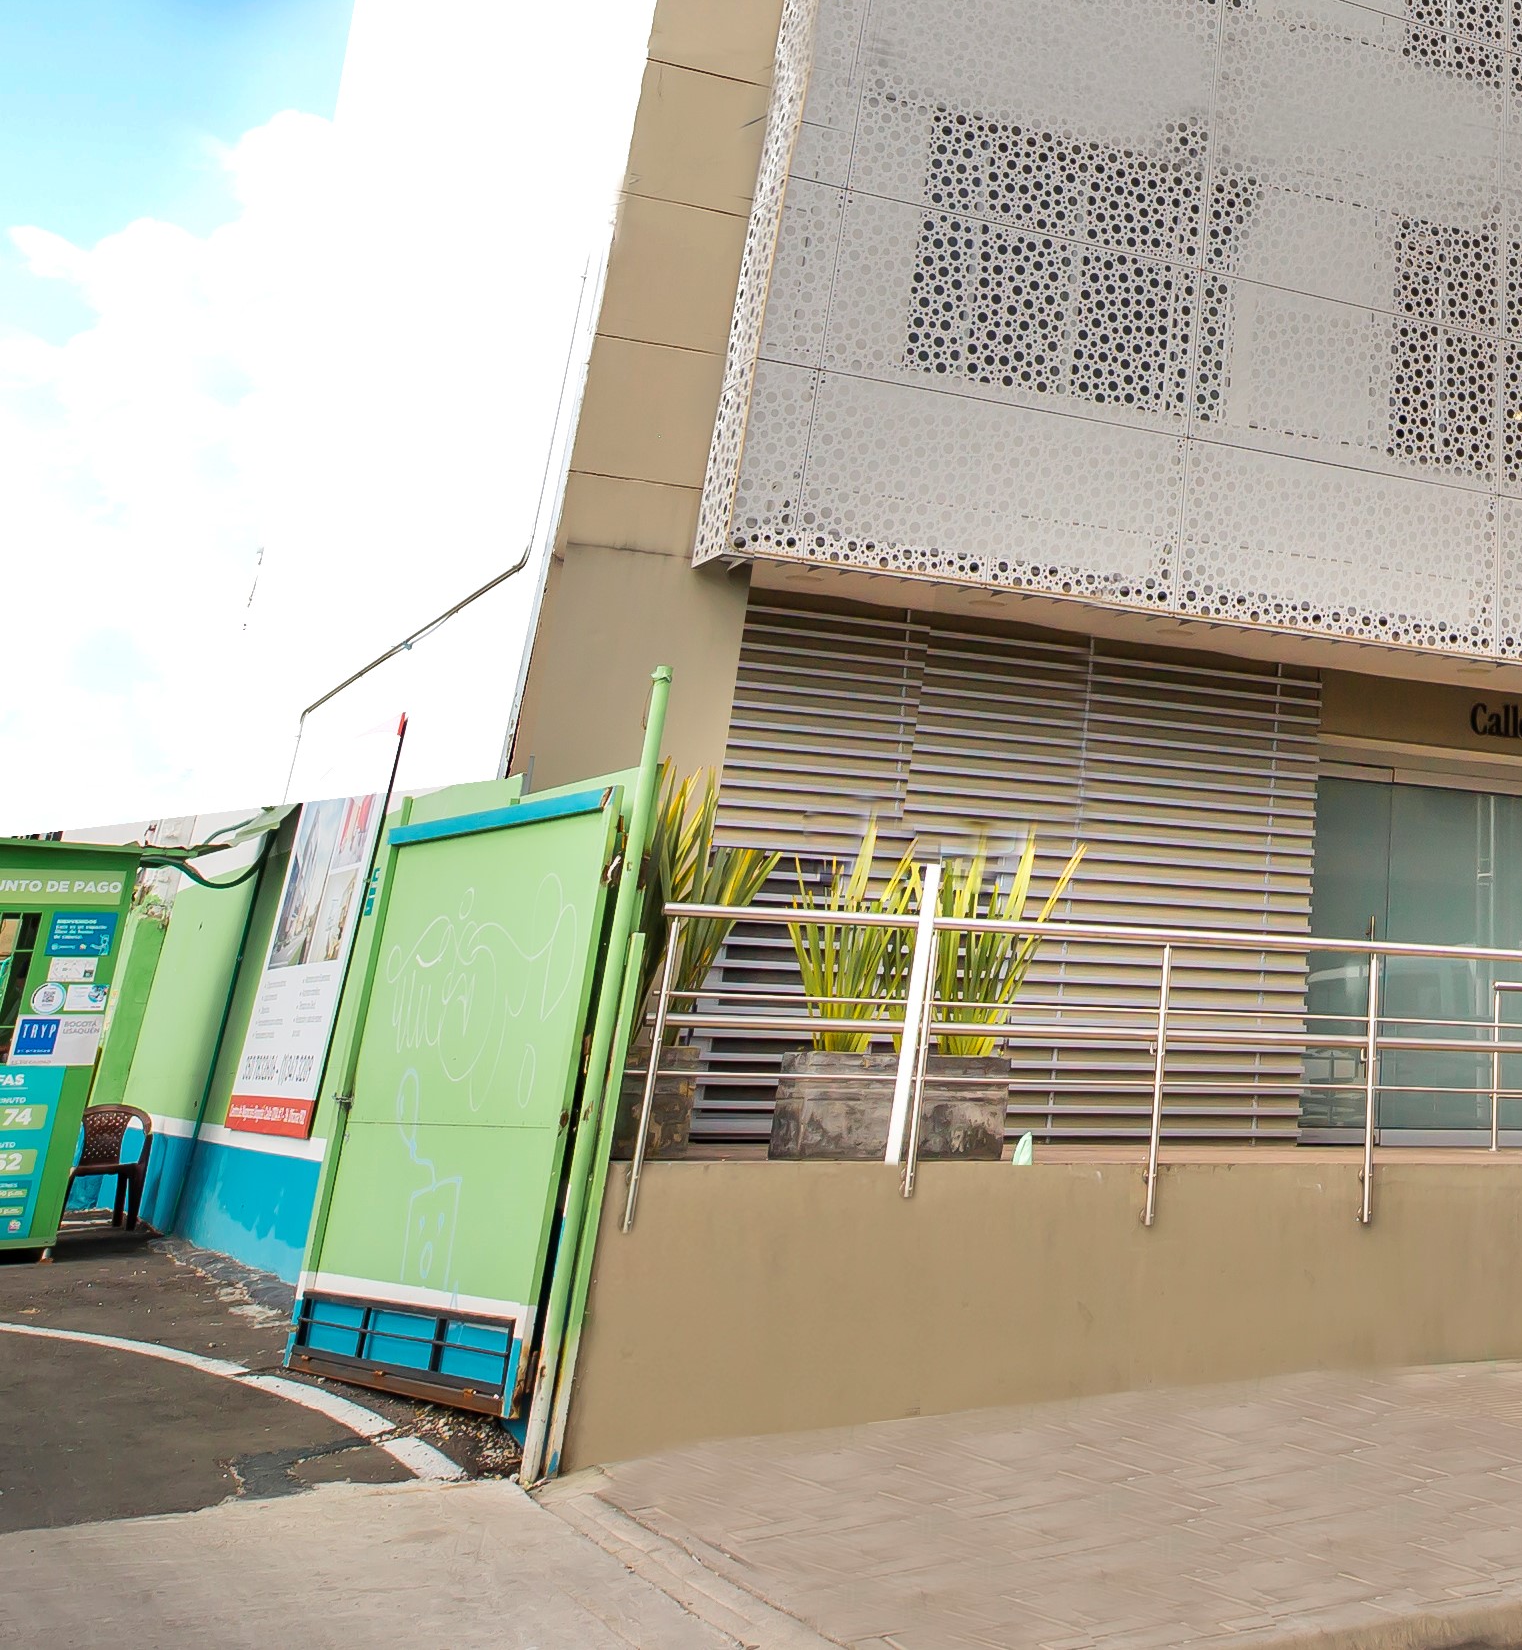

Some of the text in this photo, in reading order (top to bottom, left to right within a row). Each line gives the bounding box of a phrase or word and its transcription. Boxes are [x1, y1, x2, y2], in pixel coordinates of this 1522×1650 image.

[45, 879, 71, 893] DE
[72, 880, 123, 894] PAGO
[22, 1023, 57, 1039] TRYP
